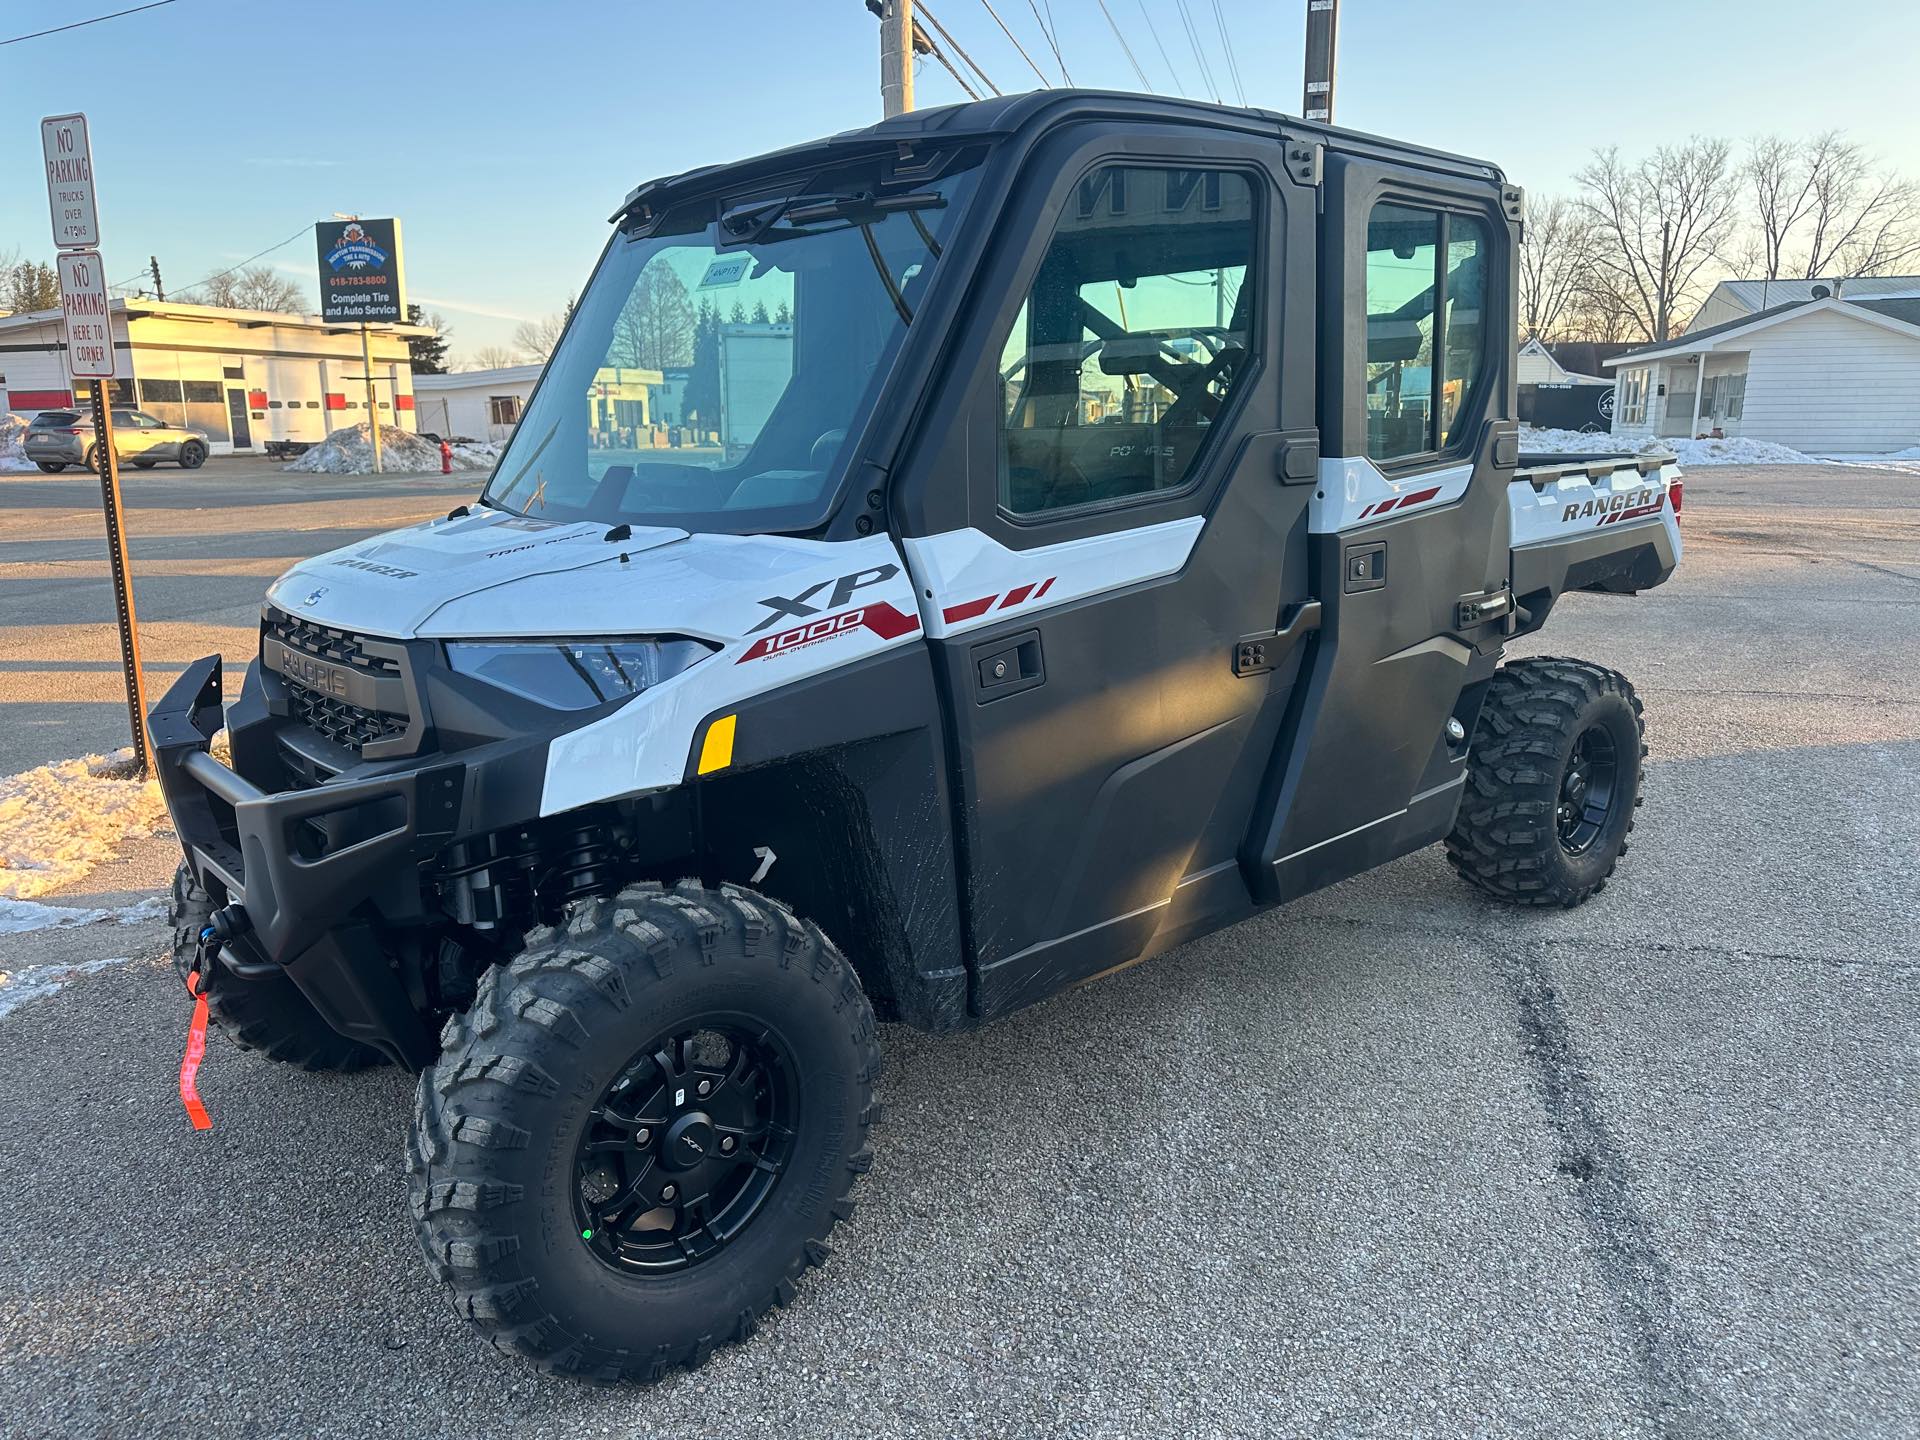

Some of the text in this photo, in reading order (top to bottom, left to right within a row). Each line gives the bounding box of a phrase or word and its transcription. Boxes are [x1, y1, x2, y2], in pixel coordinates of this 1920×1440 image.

[56, 128, 73, 154] NO
[49, 157, 88, 184] PARKING
[58, 190, 85, 202] TRUCKS
[65, 208, 82, 220] OVER
[64, 225, 87, 236] 4 TONS
[358, 253, 370, 261] AUTO
[72, 264, 90, 288] NO
[65, 293, 104, 316] PARKING
[331, 292, 390, 304] Complete Tire
[326, 305, 397, 316] and Auto Service
[72, 325, 103, 341] HERE TO
[77, 346, 105, 361] CORNER
[1110, 445, 1175, 456] POARIS
[1562, 489, 1652, 523] RANGER
[331, 559, 419, 579] RANGER
[742, 563, 900, 636] XP
[765, 609, 865, 653] 1000
[763, 627, 859, 662] DUAL OVERHEAD CAM
[681, 1135, 704, 1153] XP
